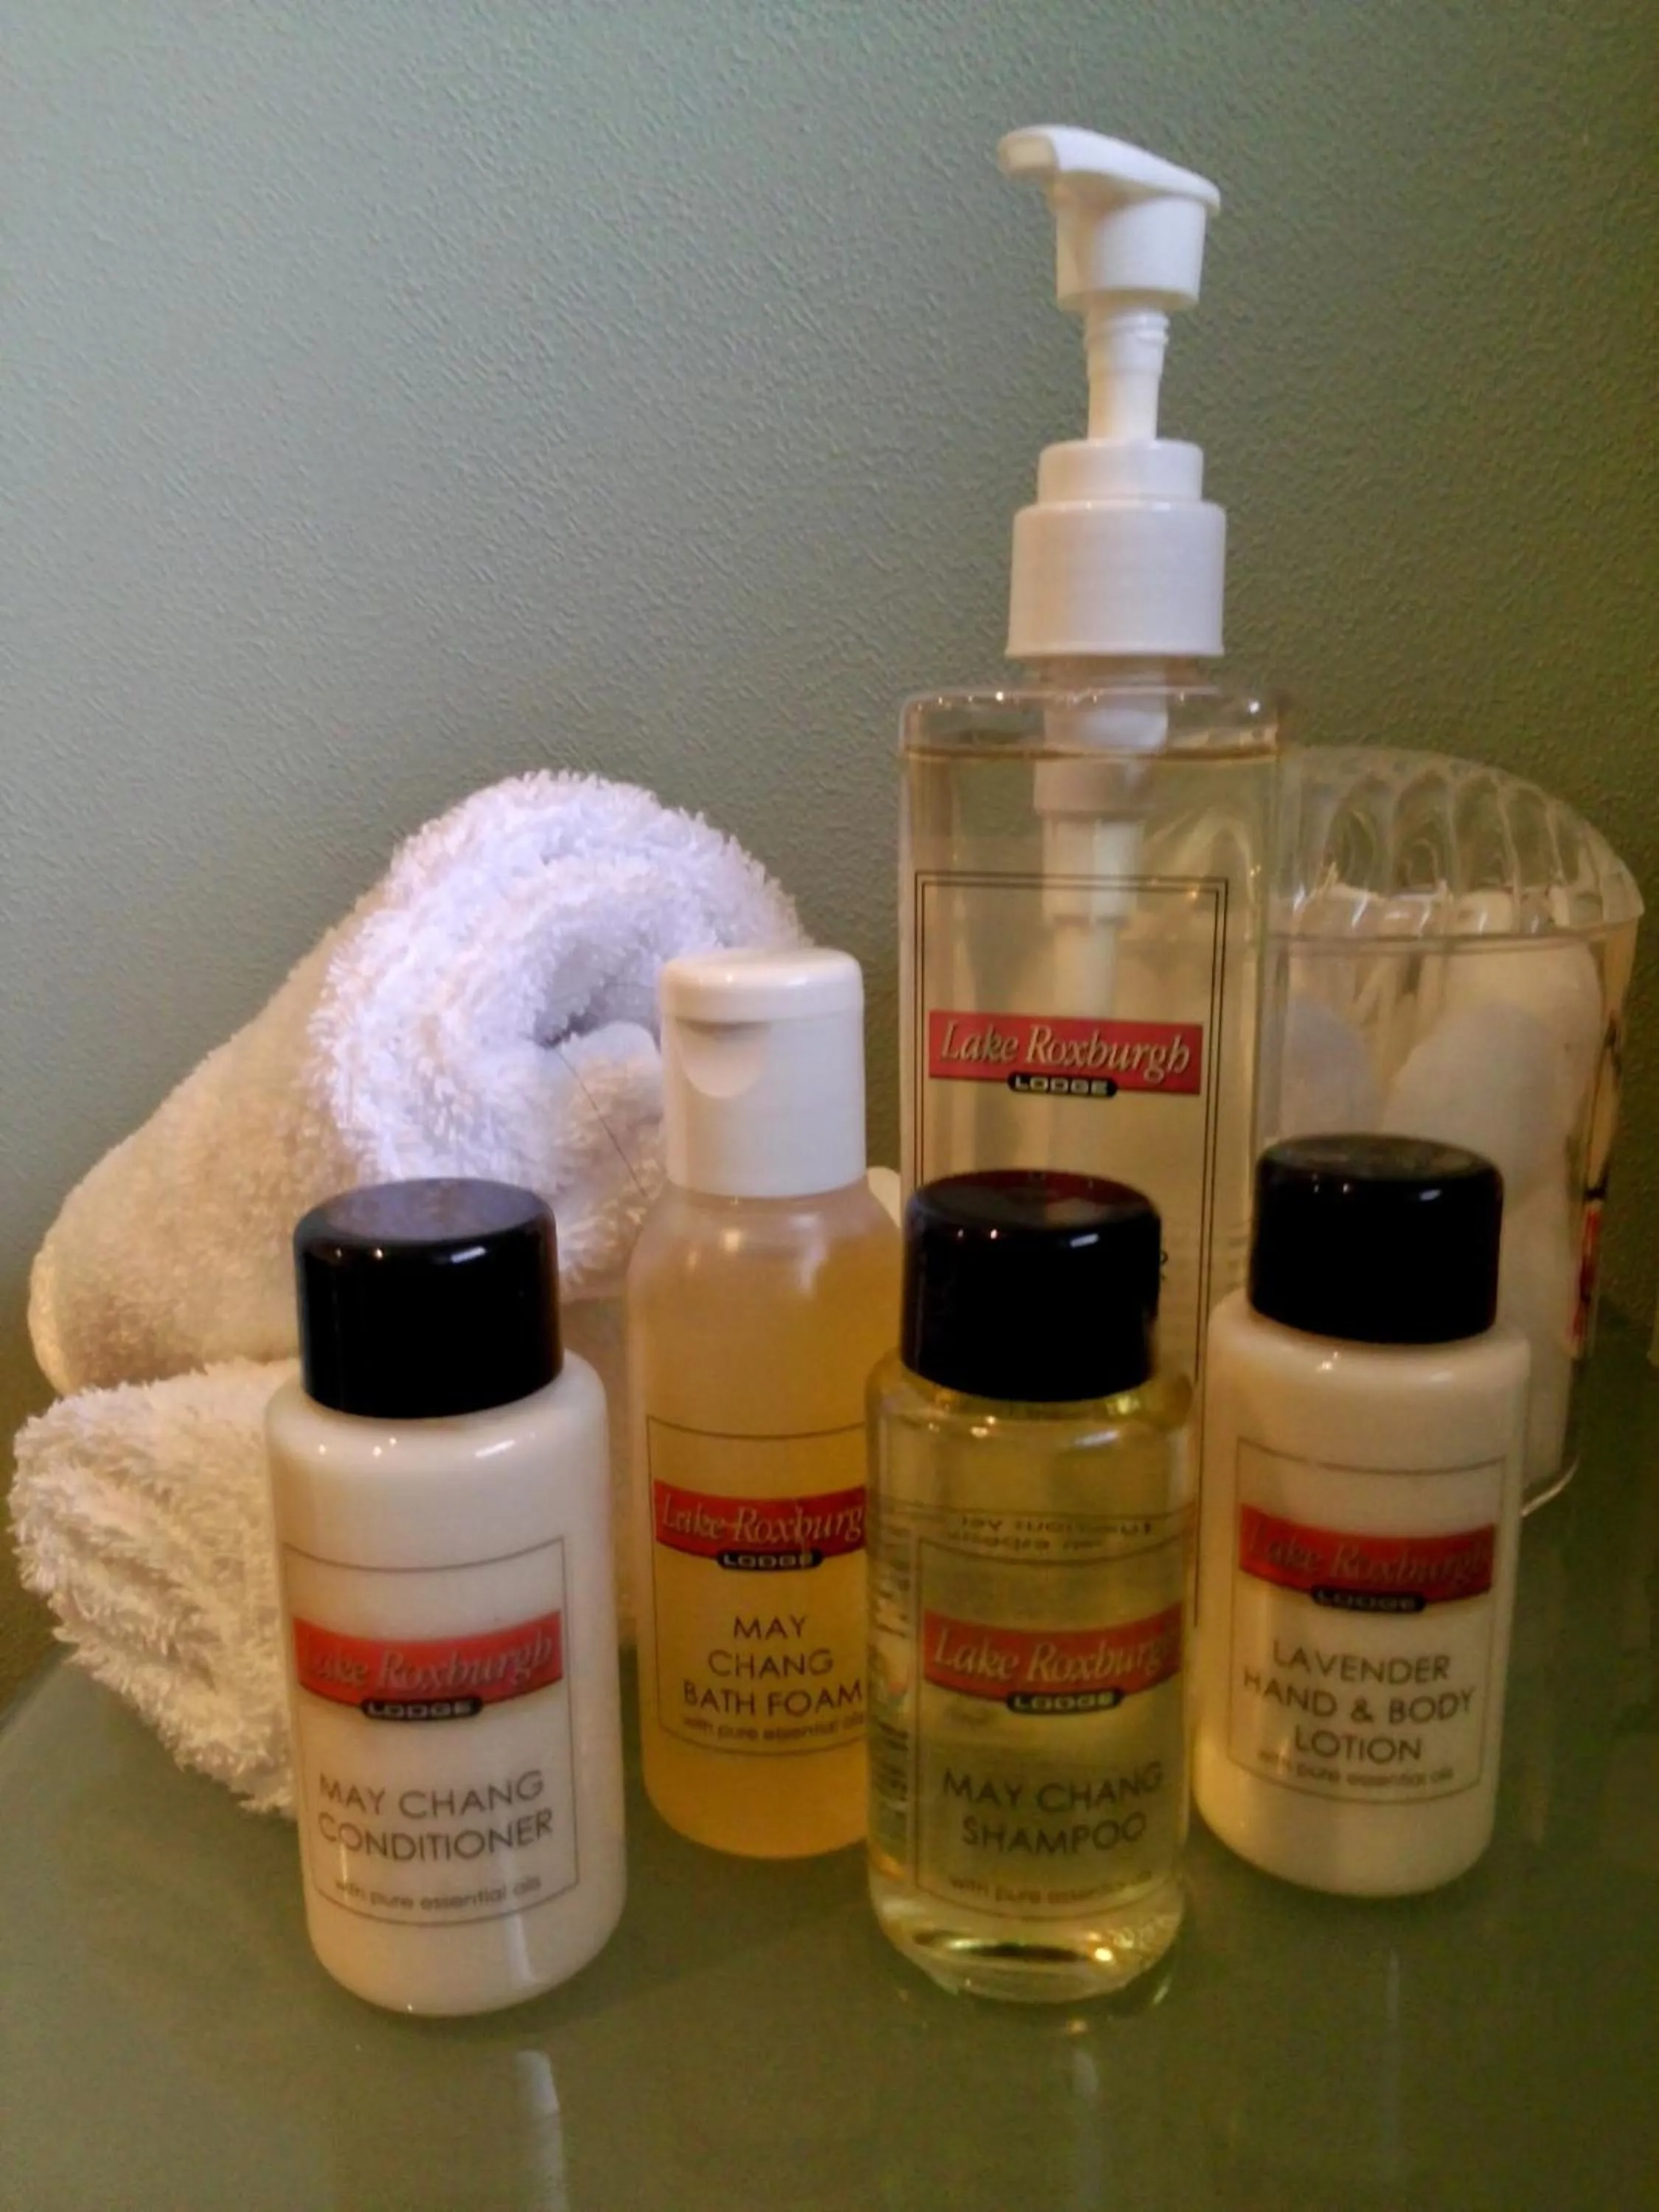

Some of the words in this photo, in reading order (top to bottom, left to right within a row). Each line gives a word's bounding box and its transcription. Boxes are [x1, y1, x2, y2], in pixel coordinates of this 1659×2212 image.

[941, 1020, 1019, 1063] Lake
[1025, 1024, 1191, 1085] Roxburgh
[1014, 1076, 1109, 1095] LODGE
[661, 1492, 723, 1539] Lake
[731, 1501, 864, 1544] Roxburg
[723, 1554, 813, 1568] LODGE
[733, 1614, 809, 1640] MAY
[376, 1628, 553, 1691] Roxburgh
[707, 1648, 835, 1679] CHANG
[933, 1625, 1020, 1682] Lake
[1273, 1639, 1451, 1686] LAVENDER
[367, 1700, 474, 1719] LODGE
[682, 1679, 757, 1716] BATH
[768, 1679, 863, 1718] FOAM
[1013, 1691, 1116, 1711] LODGE
[1244, 1669, 1338, 1719] HAND
[1350, 1697, 1374, 1724] &
[1388, 1688, 1474, 1725] BODY
[1295, 1725, 1423, 1764] LOTION
[319, 1772, 386, 1817] MAY
[398, 1770, 544, 1820] CHANG
[942, 1769, 1025, 1810] MAY
[1035, 1761, 1164, 1814] CHANG
[318, 1808, 553, 1863] CONDITIONER
[961, 1811, 1148, 1857] SHAMPOO
[369, 1890, 414, 1910] pure
[420, 1882, 507, 1911] essential
